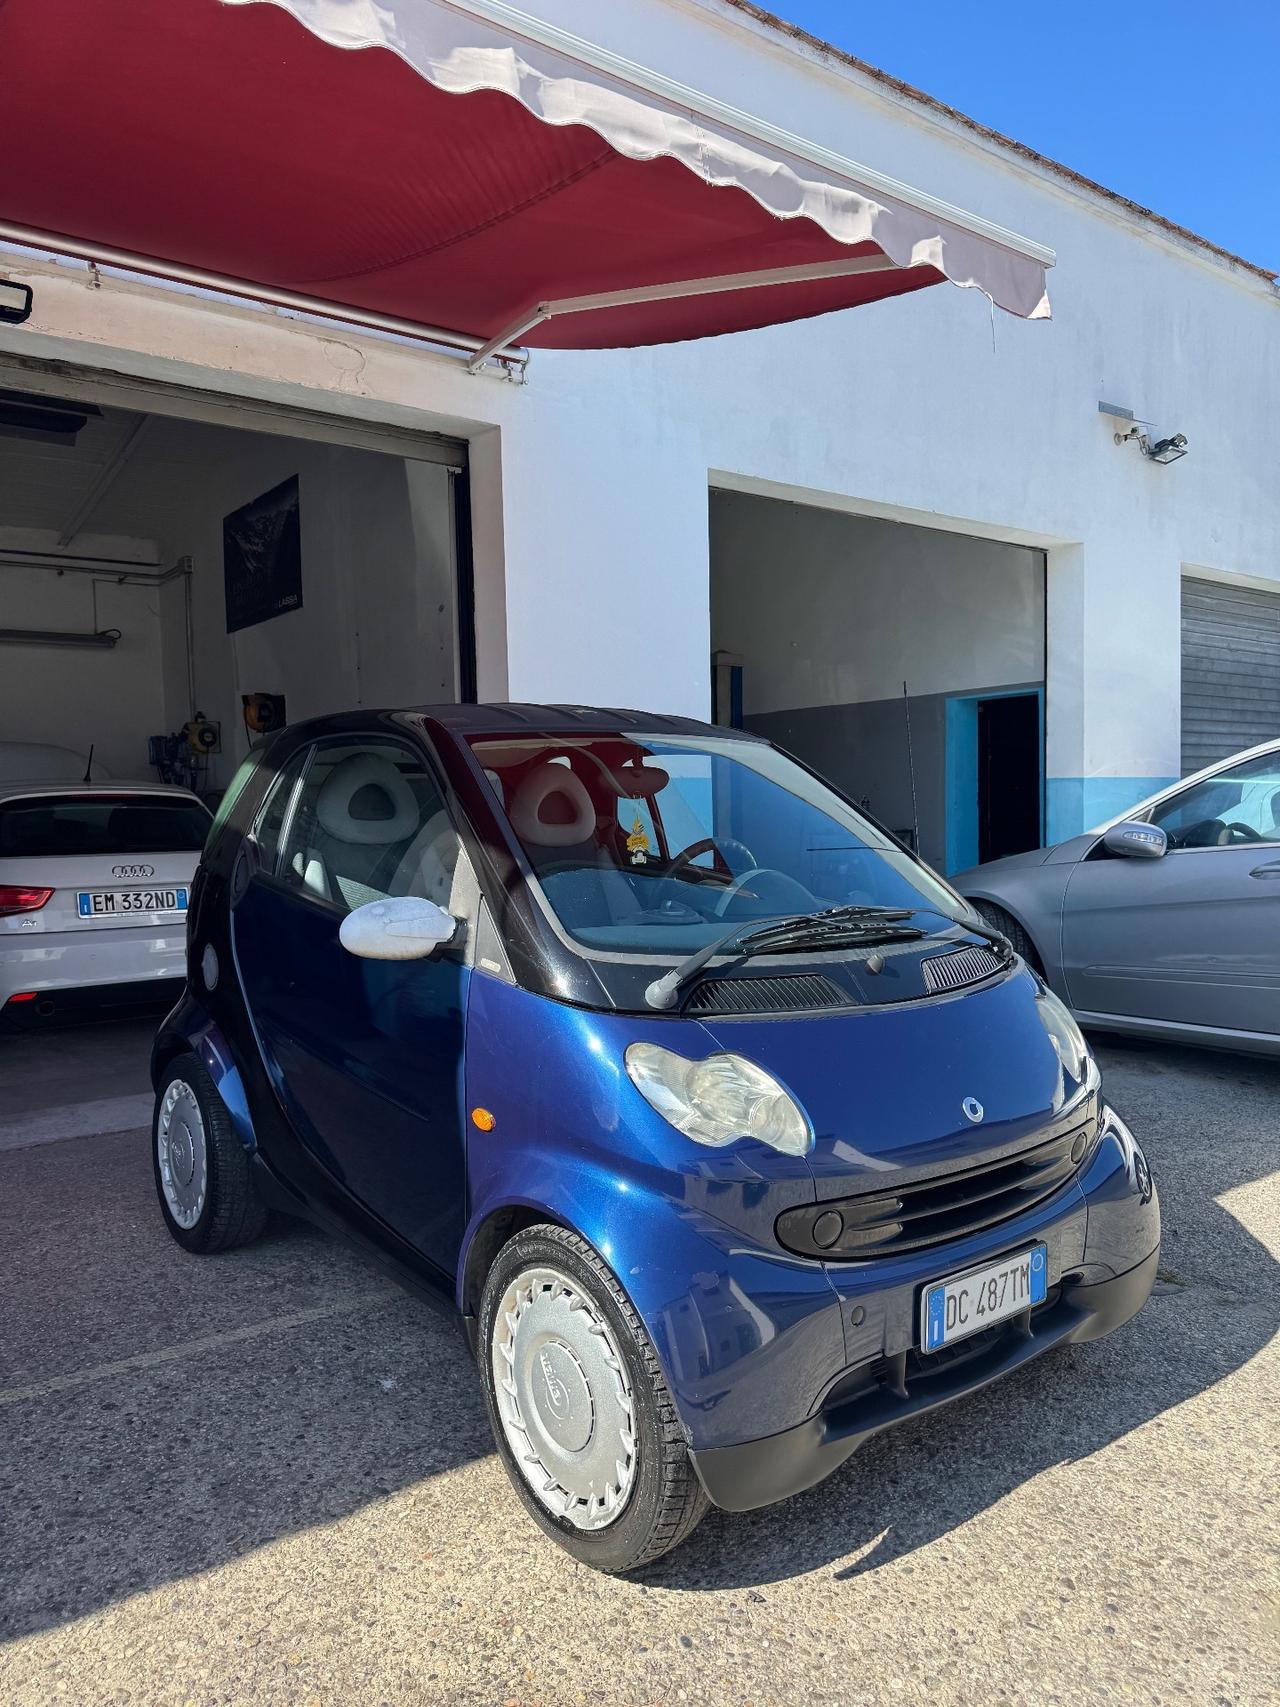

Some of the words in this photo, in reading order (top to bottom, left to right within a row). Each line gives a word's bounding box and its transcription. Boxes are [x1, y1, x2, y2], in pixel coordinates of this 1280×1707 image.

[92, 894, 116, 912] EM
[121, 891, 176, 910] 332ND
[946, 1289, 969, 1331] DC
[976, 1262, 1030, 1317] 487TM
